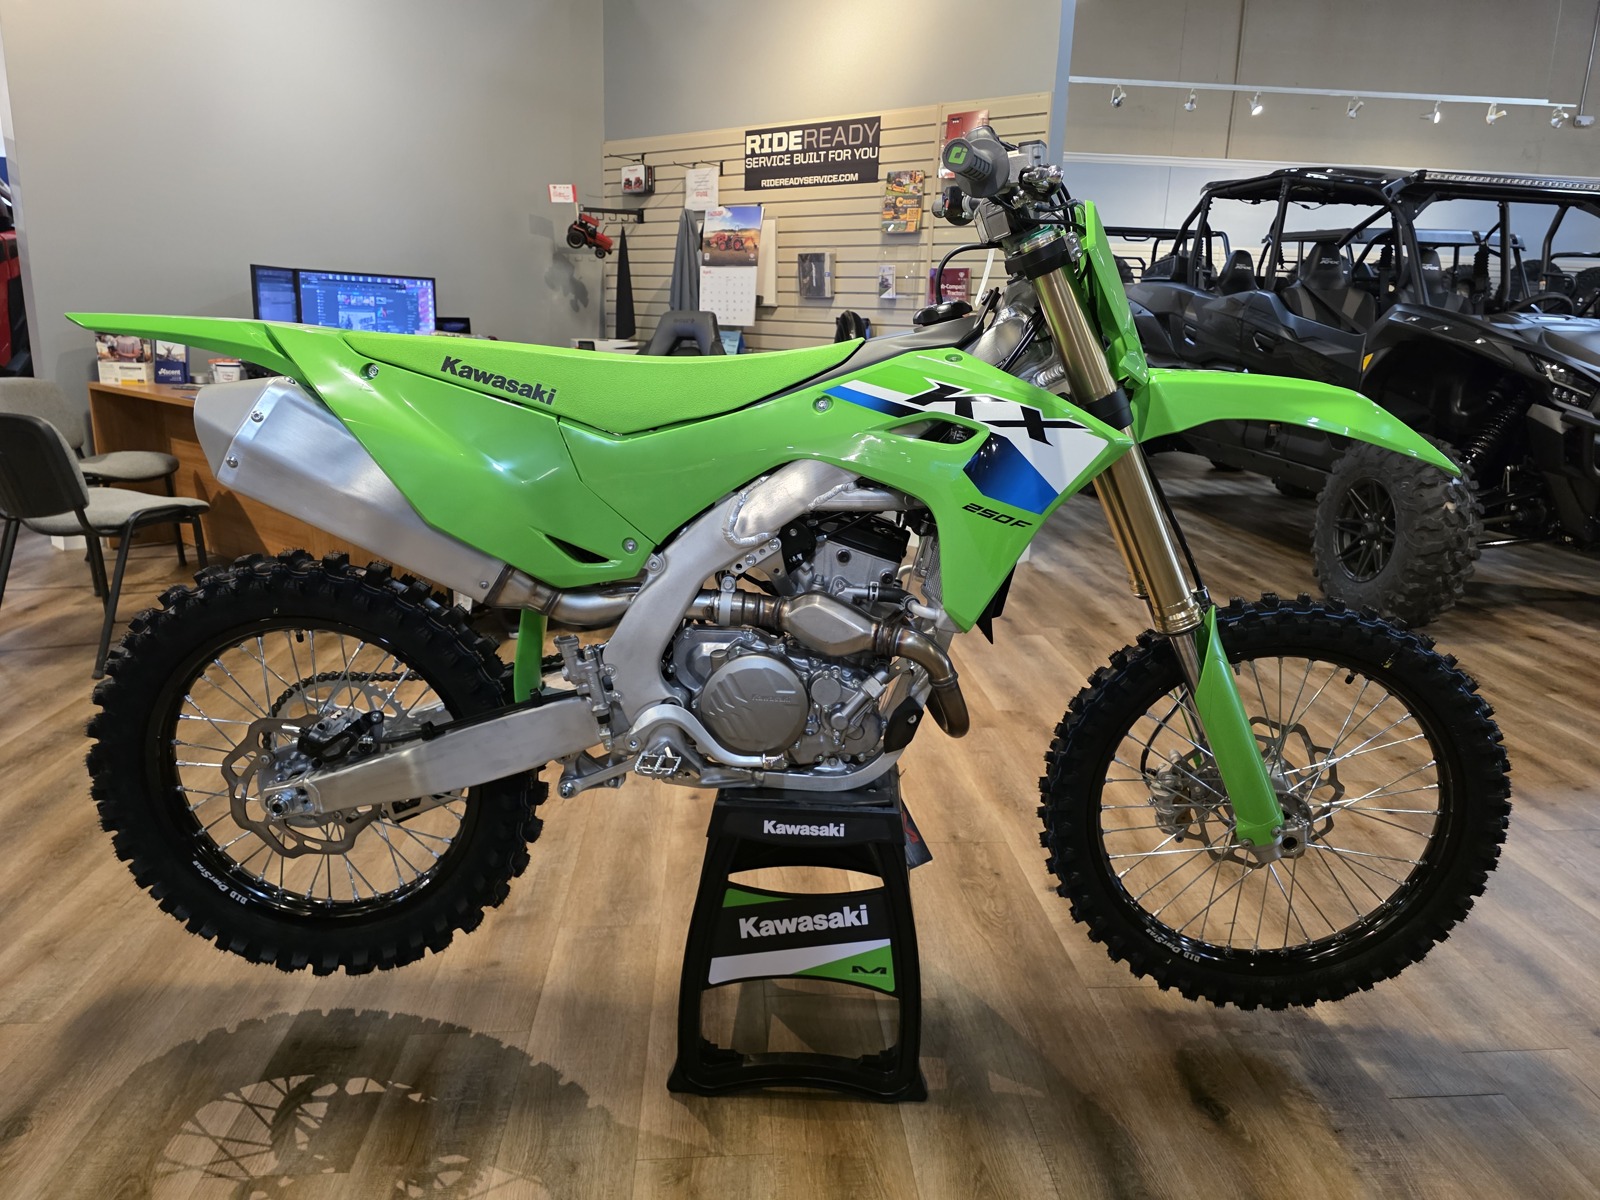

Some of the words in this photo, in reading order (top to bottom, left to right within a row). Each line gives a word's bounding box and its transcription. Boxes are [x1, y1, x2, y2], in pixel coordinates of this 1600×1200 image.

[745, 122, 879, 155] RIDEREADY
[745, 154, 791, 169] SERVICE
[793, 151, 826, 165] BUILT
[828, 149, 851, 162] FOR
[853, 147, 878, 160] YOU
[761, 173, 859, 188] RIDEREADYSERVICE.COM
[440, 355, 557, 405] Kawasaki
[962, 502, 1033, 528] 250F
[763, 819, 845, 837] Kawasaki
[739, 904, 869, 939] Kawasaki
